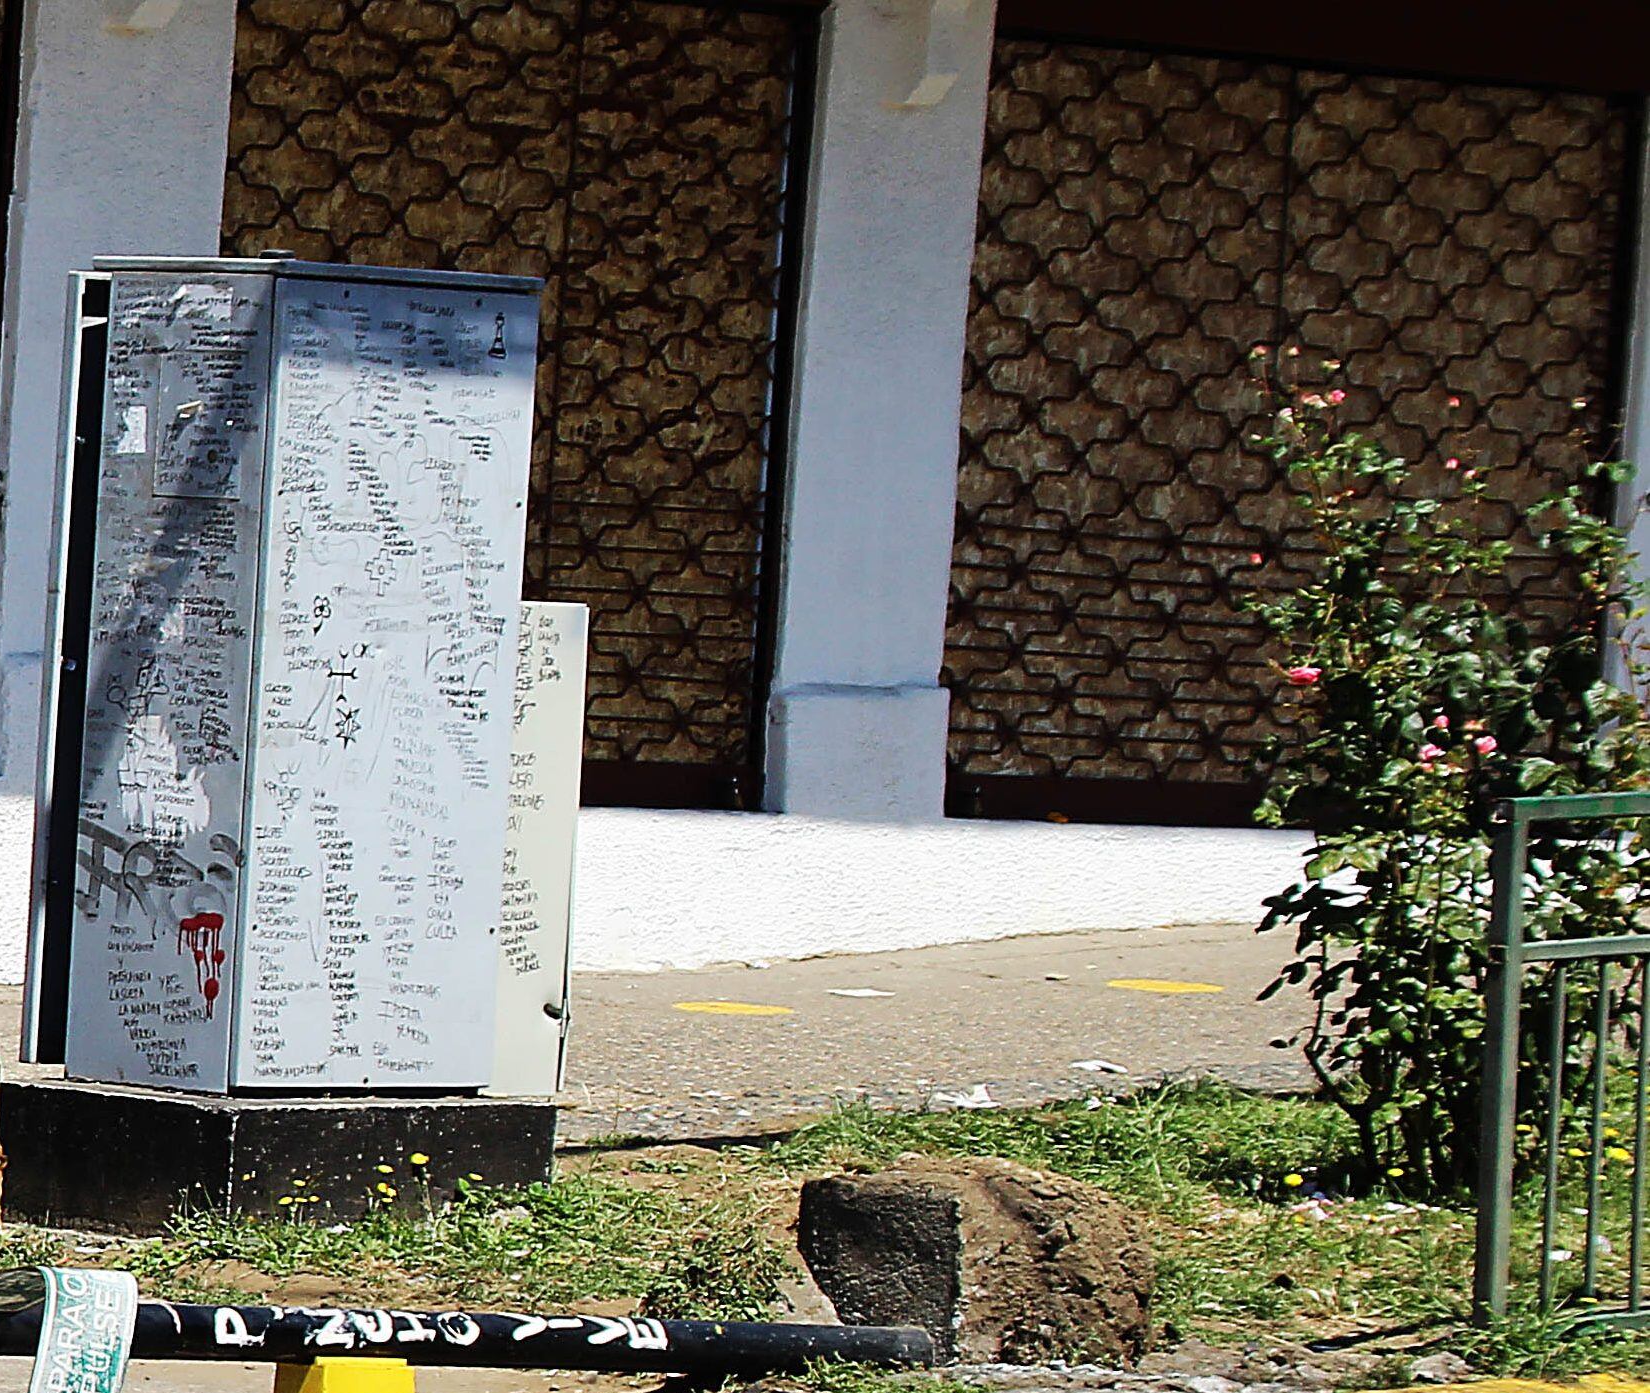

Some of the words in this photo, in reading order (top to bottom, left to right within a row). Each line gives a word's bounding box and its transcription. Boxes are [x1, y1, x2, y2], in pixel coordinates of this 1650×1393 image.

[49, 1303, 87, 1393] PARA
[214, 1304, 482, 1349] PNCHO
[501, 1312, 670, 1351] VIVE
